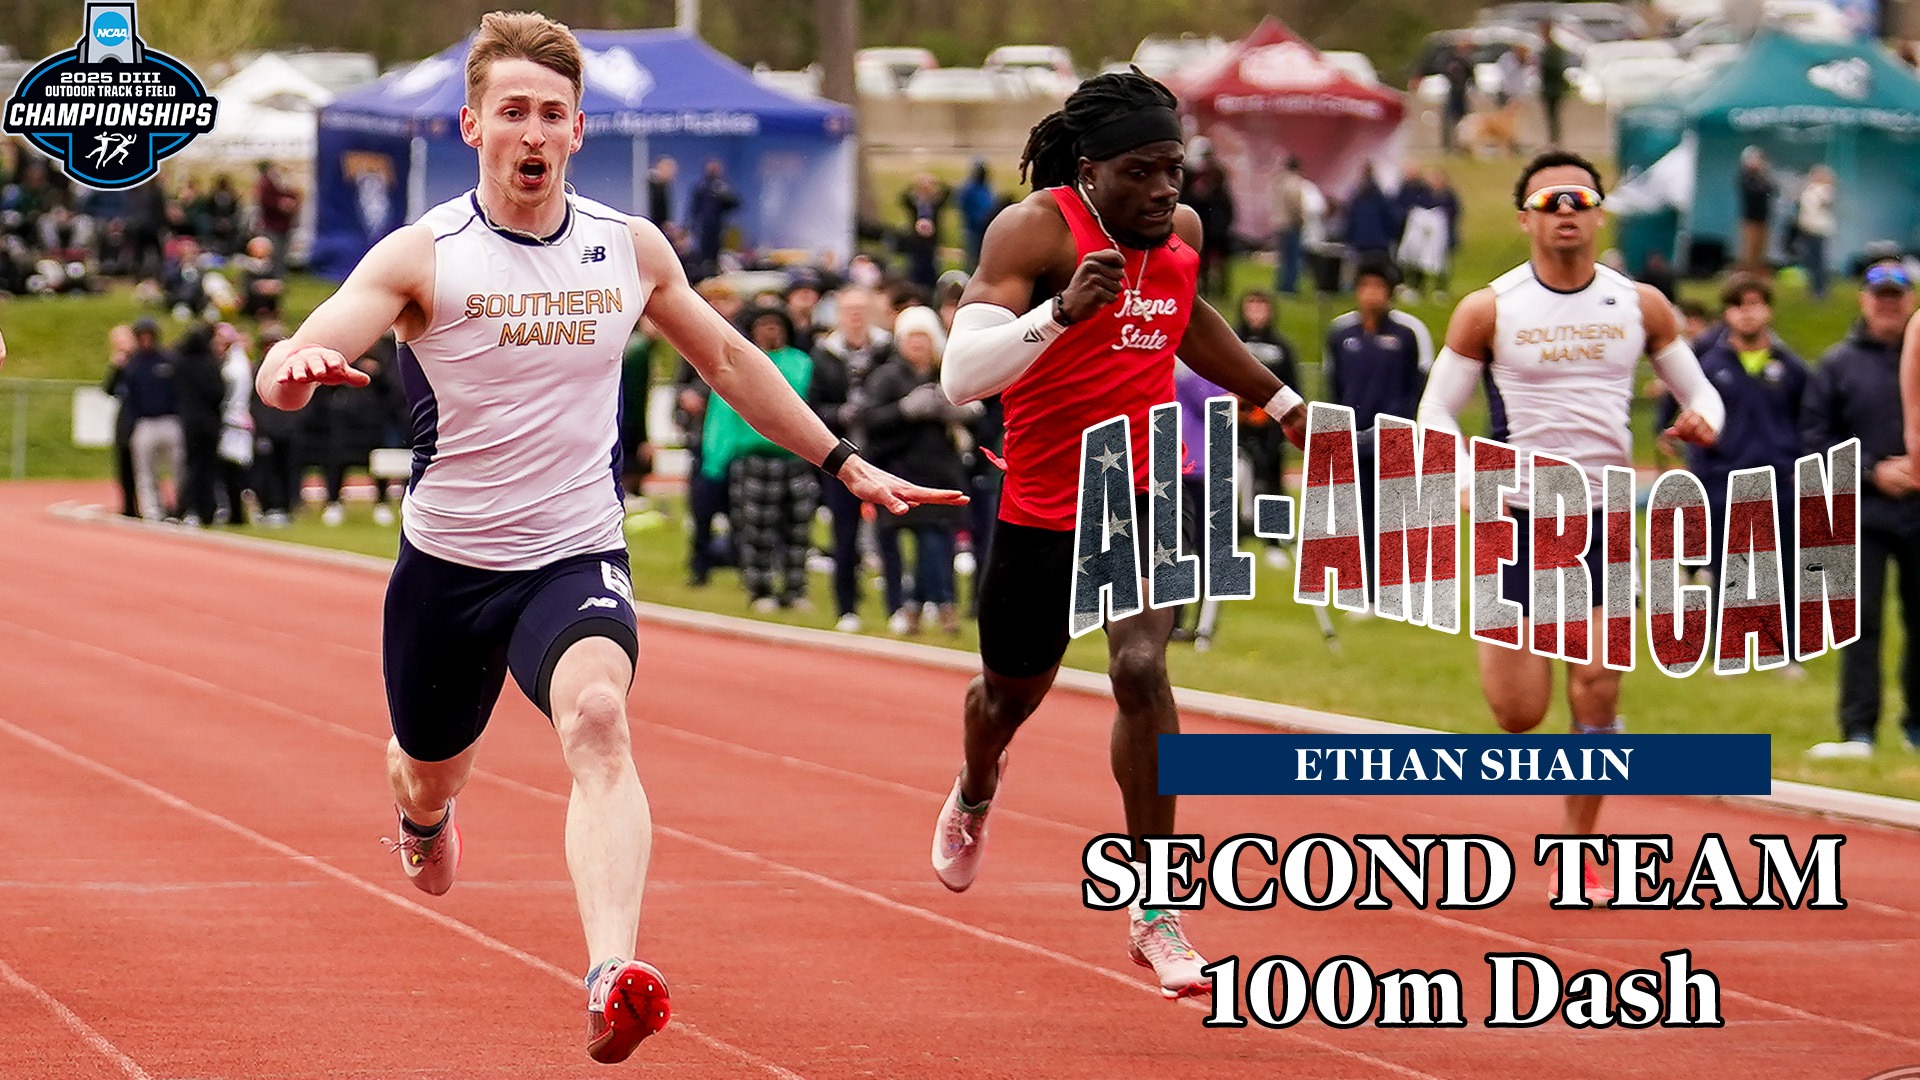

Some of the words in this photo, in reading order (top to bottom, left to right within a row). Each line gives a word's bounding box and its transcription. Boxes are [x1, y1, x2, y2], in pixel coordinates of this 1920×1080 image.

[465, 287, 623, 319] SOUTHERN
[499, 320, 597, 347] MAINE
[1111, 323, 1168, 351] State
[1515, 323, 1625, 346] SOUTHERN
[1540, 343, 1606, 363] MAINE
